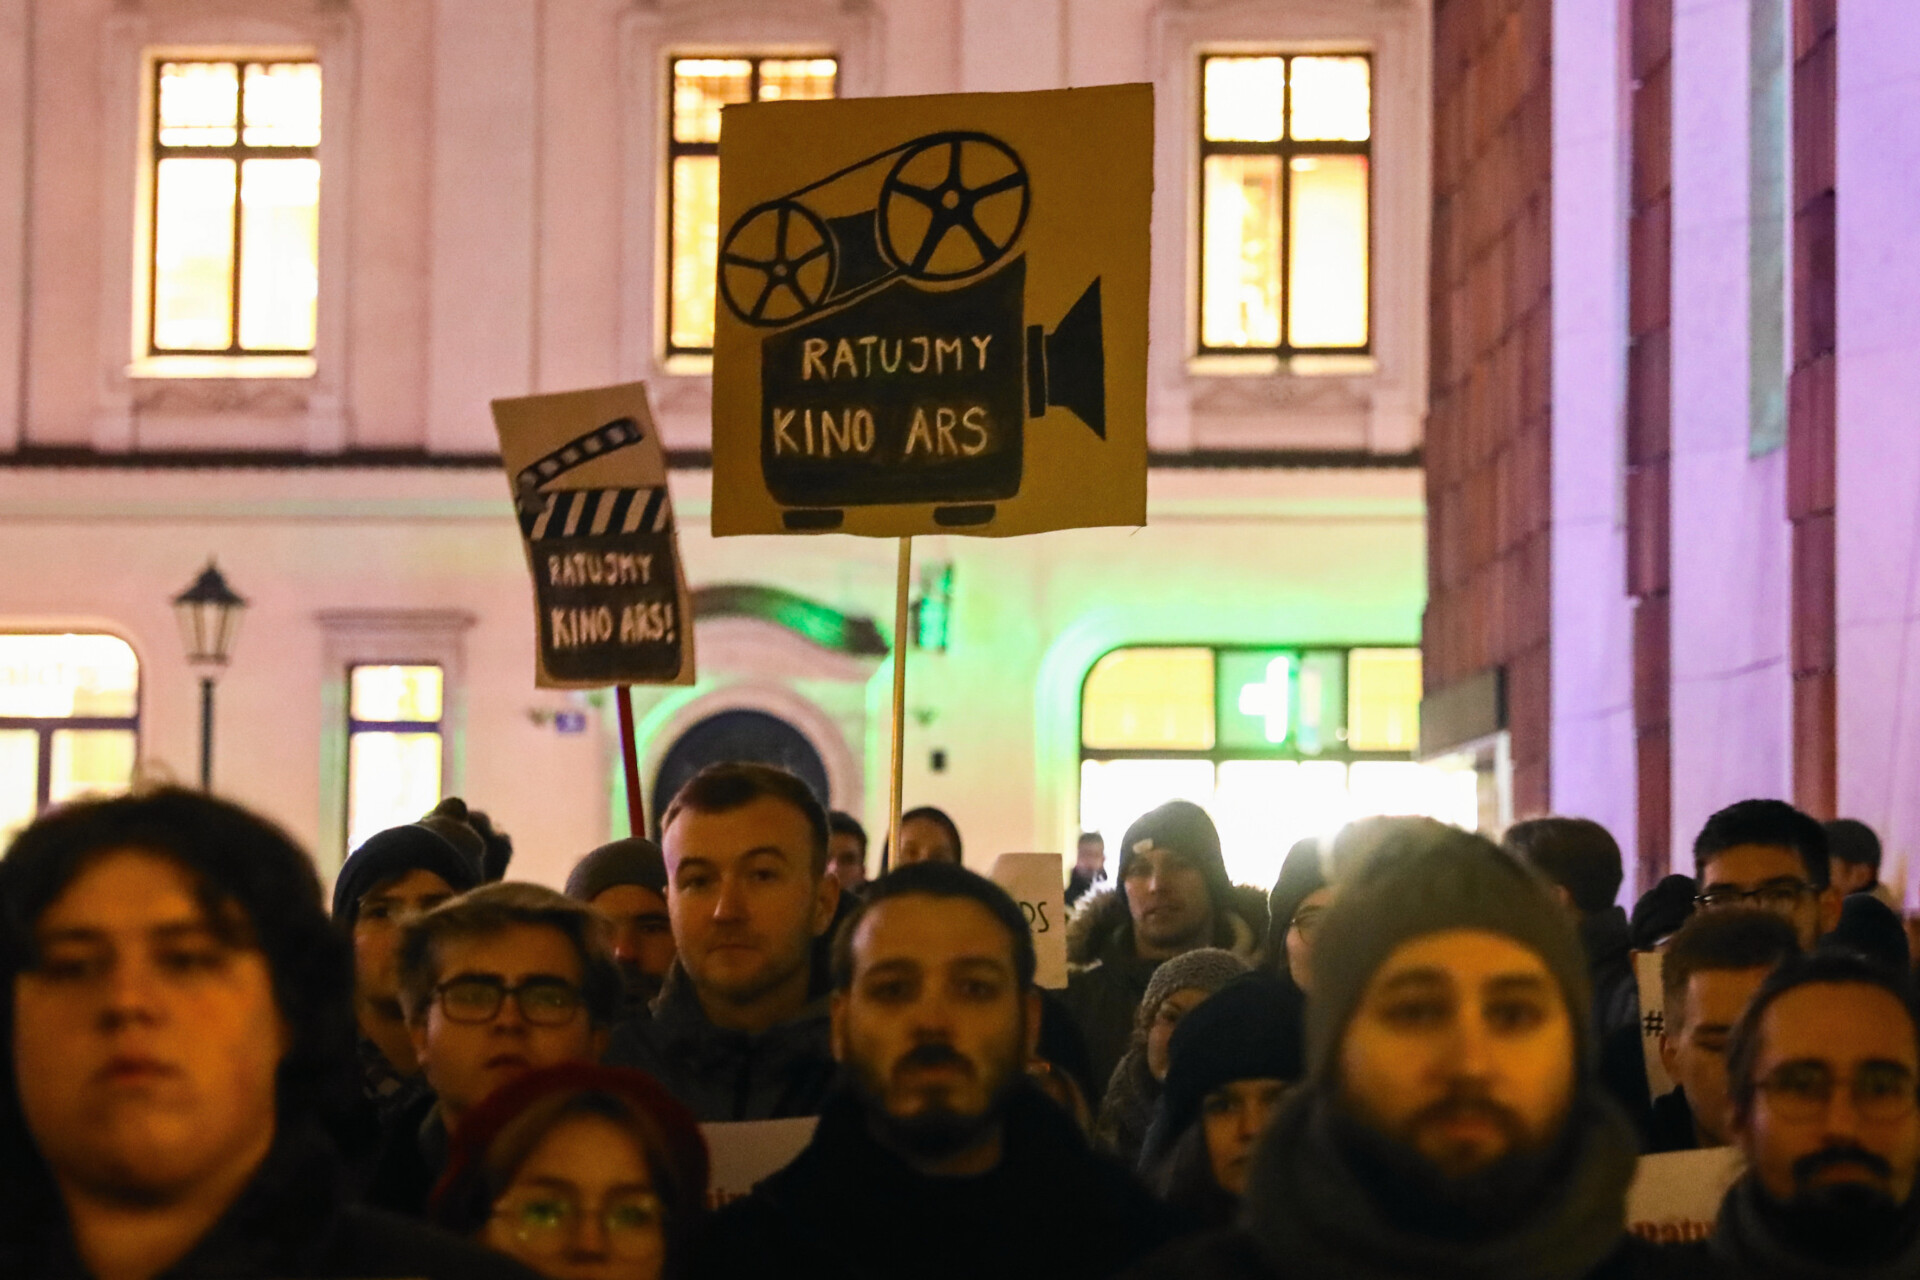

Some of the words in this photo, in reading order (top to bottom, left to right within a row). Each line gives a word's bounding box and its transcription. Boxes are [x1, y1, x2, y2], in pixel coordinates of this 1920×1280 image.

[802, 333, 993, 381] RATUJMY
[773, 407, 876, 457] KINO
[904, 406, 988, 456] ARS
[548, 551, 653, 586] RATUJMY
[551, 604, 613, 650] KINO
[619, 601, 676, 645] ARS!
